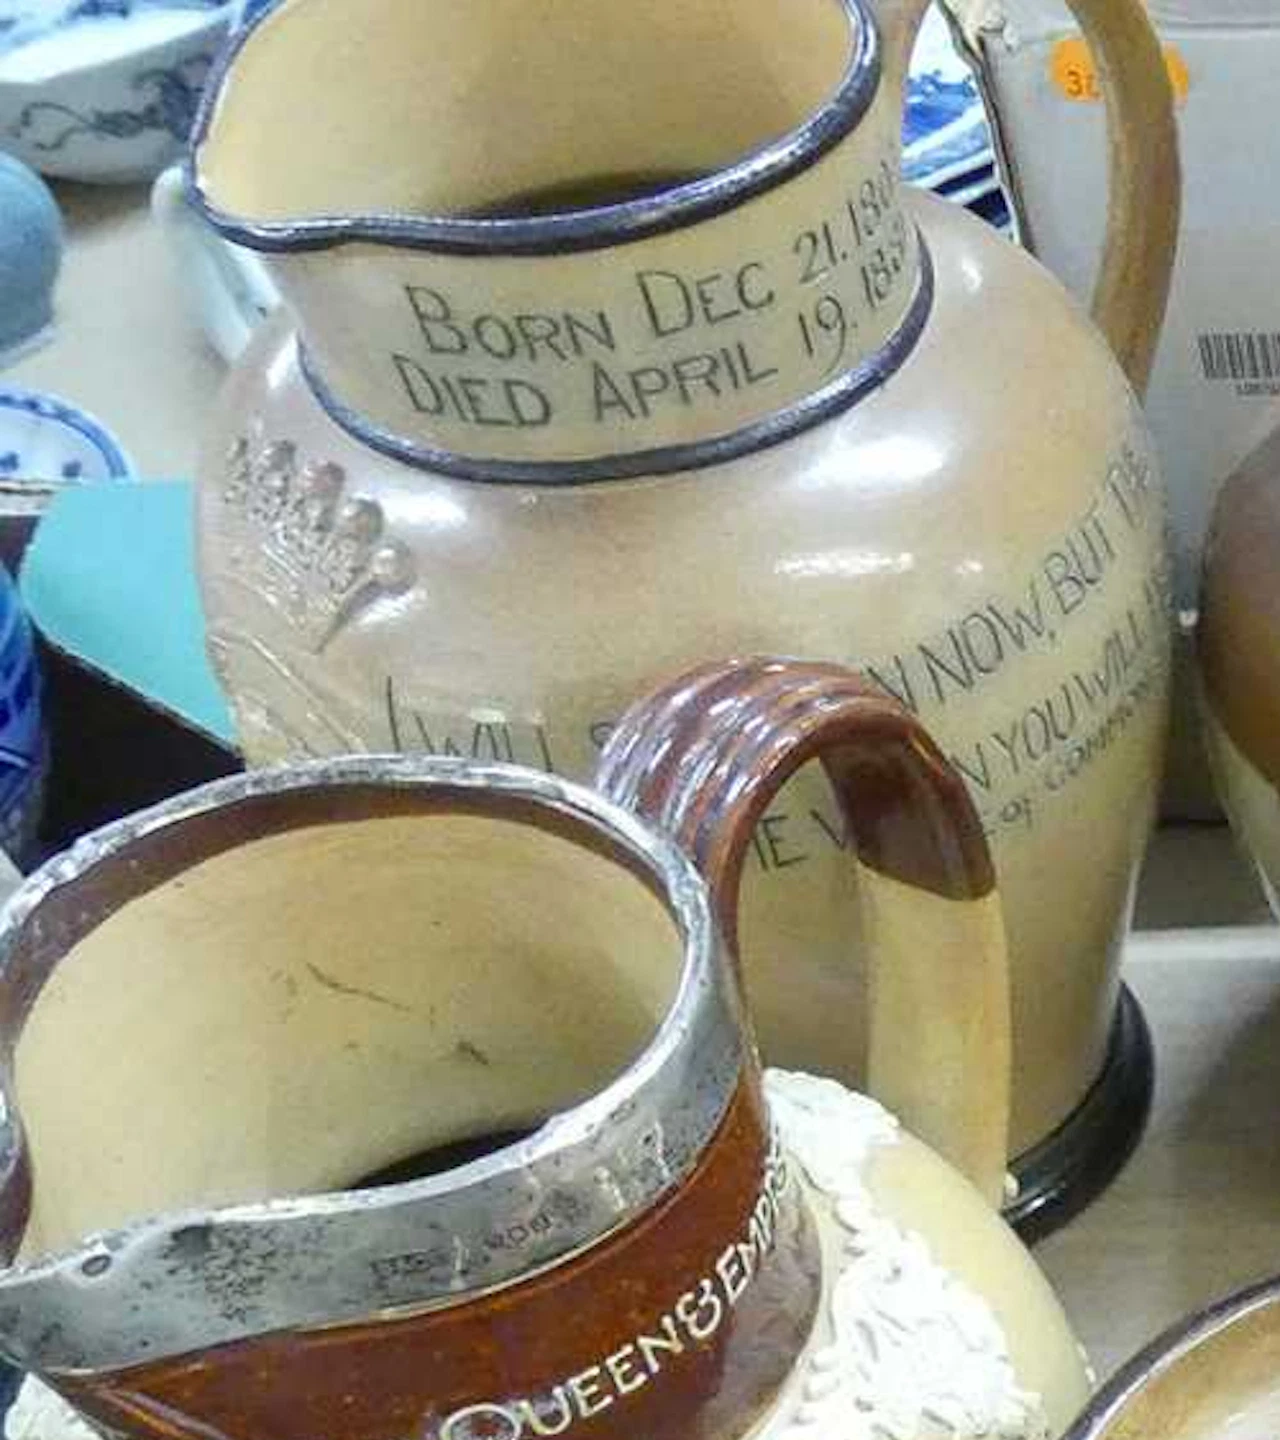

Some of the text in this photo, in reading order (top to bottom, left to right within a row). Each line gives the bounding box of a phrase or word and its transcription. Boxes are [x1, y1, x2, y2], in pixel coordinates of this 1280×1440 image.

[404, 283, 616, 363] BORN
[636, 262, 775, 338] DEC
[391, 352, 553, 429] DIED
[592, 339, 779, 422] APRIL
[1044, 498, 1116, 615] BUT
[990, 683, 1077, 775] YOU
